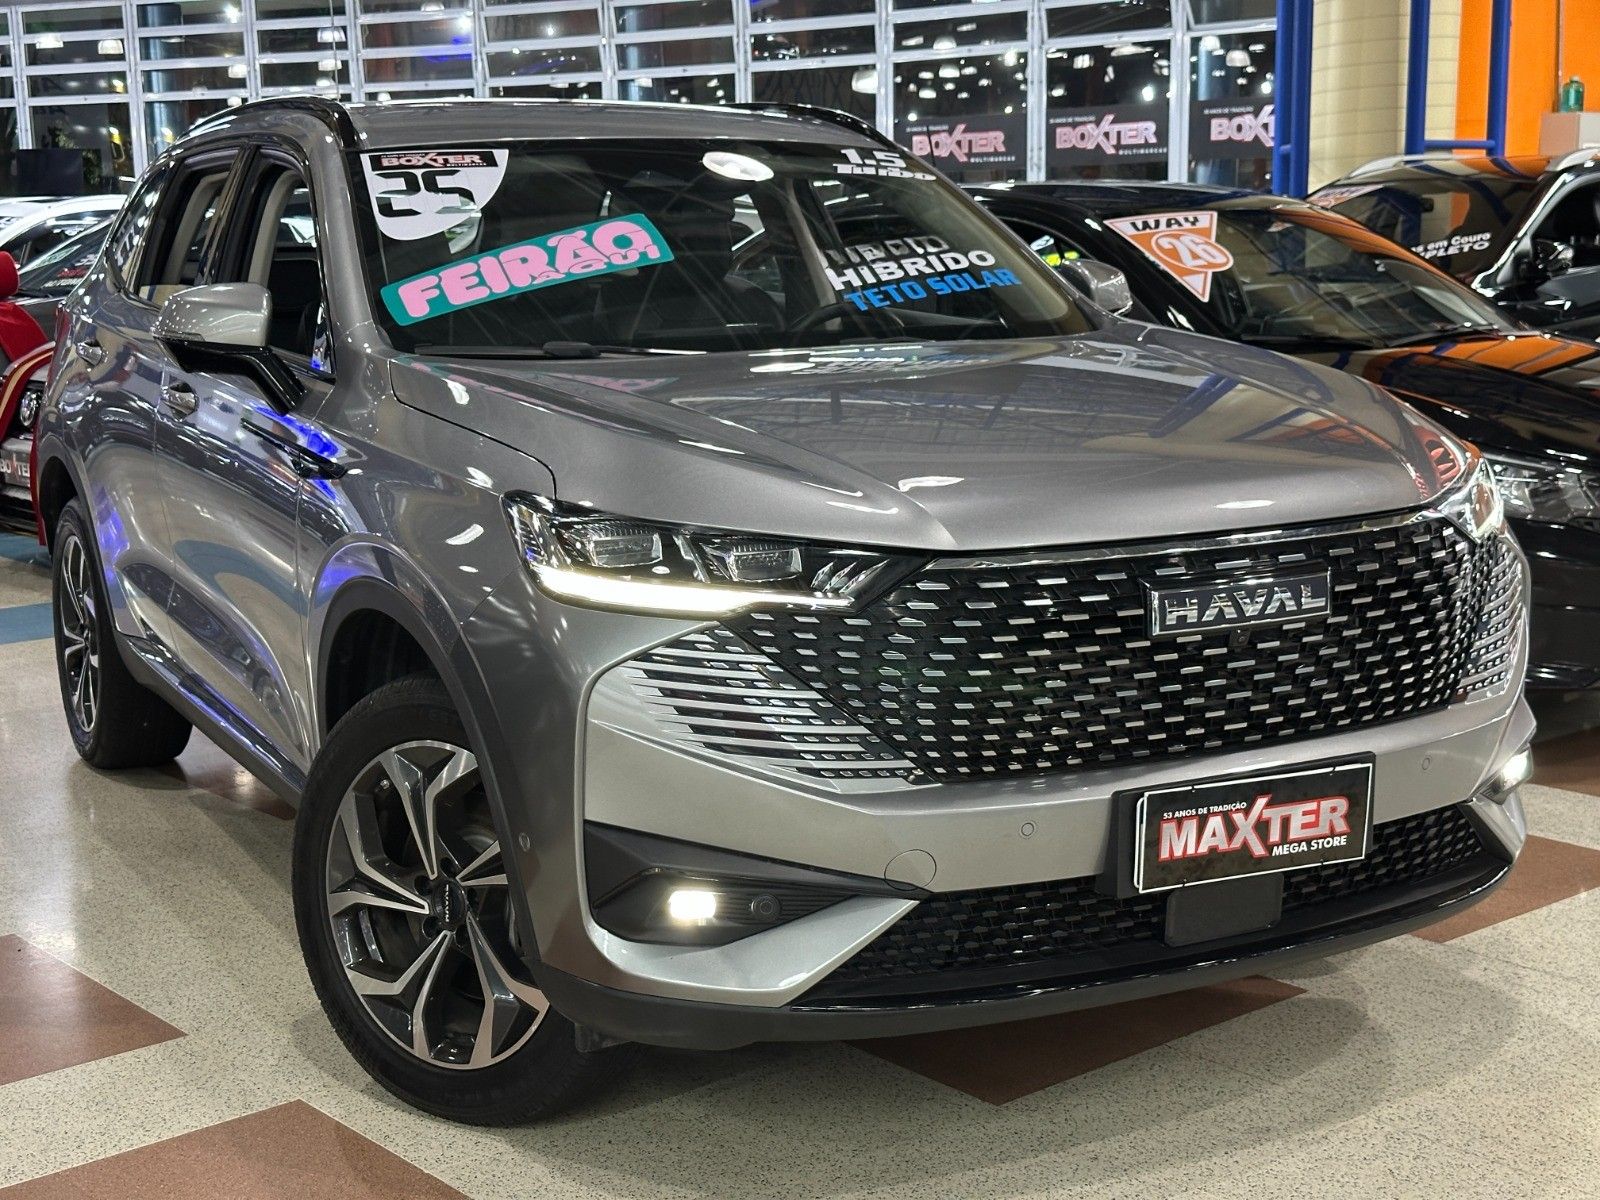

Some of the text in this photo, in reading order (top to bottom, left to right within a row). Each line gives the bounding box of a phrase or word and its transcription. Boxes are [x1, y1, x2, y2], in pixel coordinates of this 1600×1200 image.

[911, 123, 1006, 162] BOXTER
[1056, 113, 1157, 155] BOXTER
[1210, 104, 1275, 147] BOXT
[381, 152, 482, 167] BOXTER
[841, 148, 906, 168] 1.5
[1130, 216, 1199, 232] WAY
[1157, 235, 1229, 267] 26
[843, 268, 1022, 311] TETO SOLAR
[1165, 584, 1326, 625] HAVAL
[1158, 794, 1351, 862] MAXTER
[1163, 801, 1247, 820] 53 ANOS DE TRADIÇÃO
[1272, 835, 1347, 857] MEGA STORE
